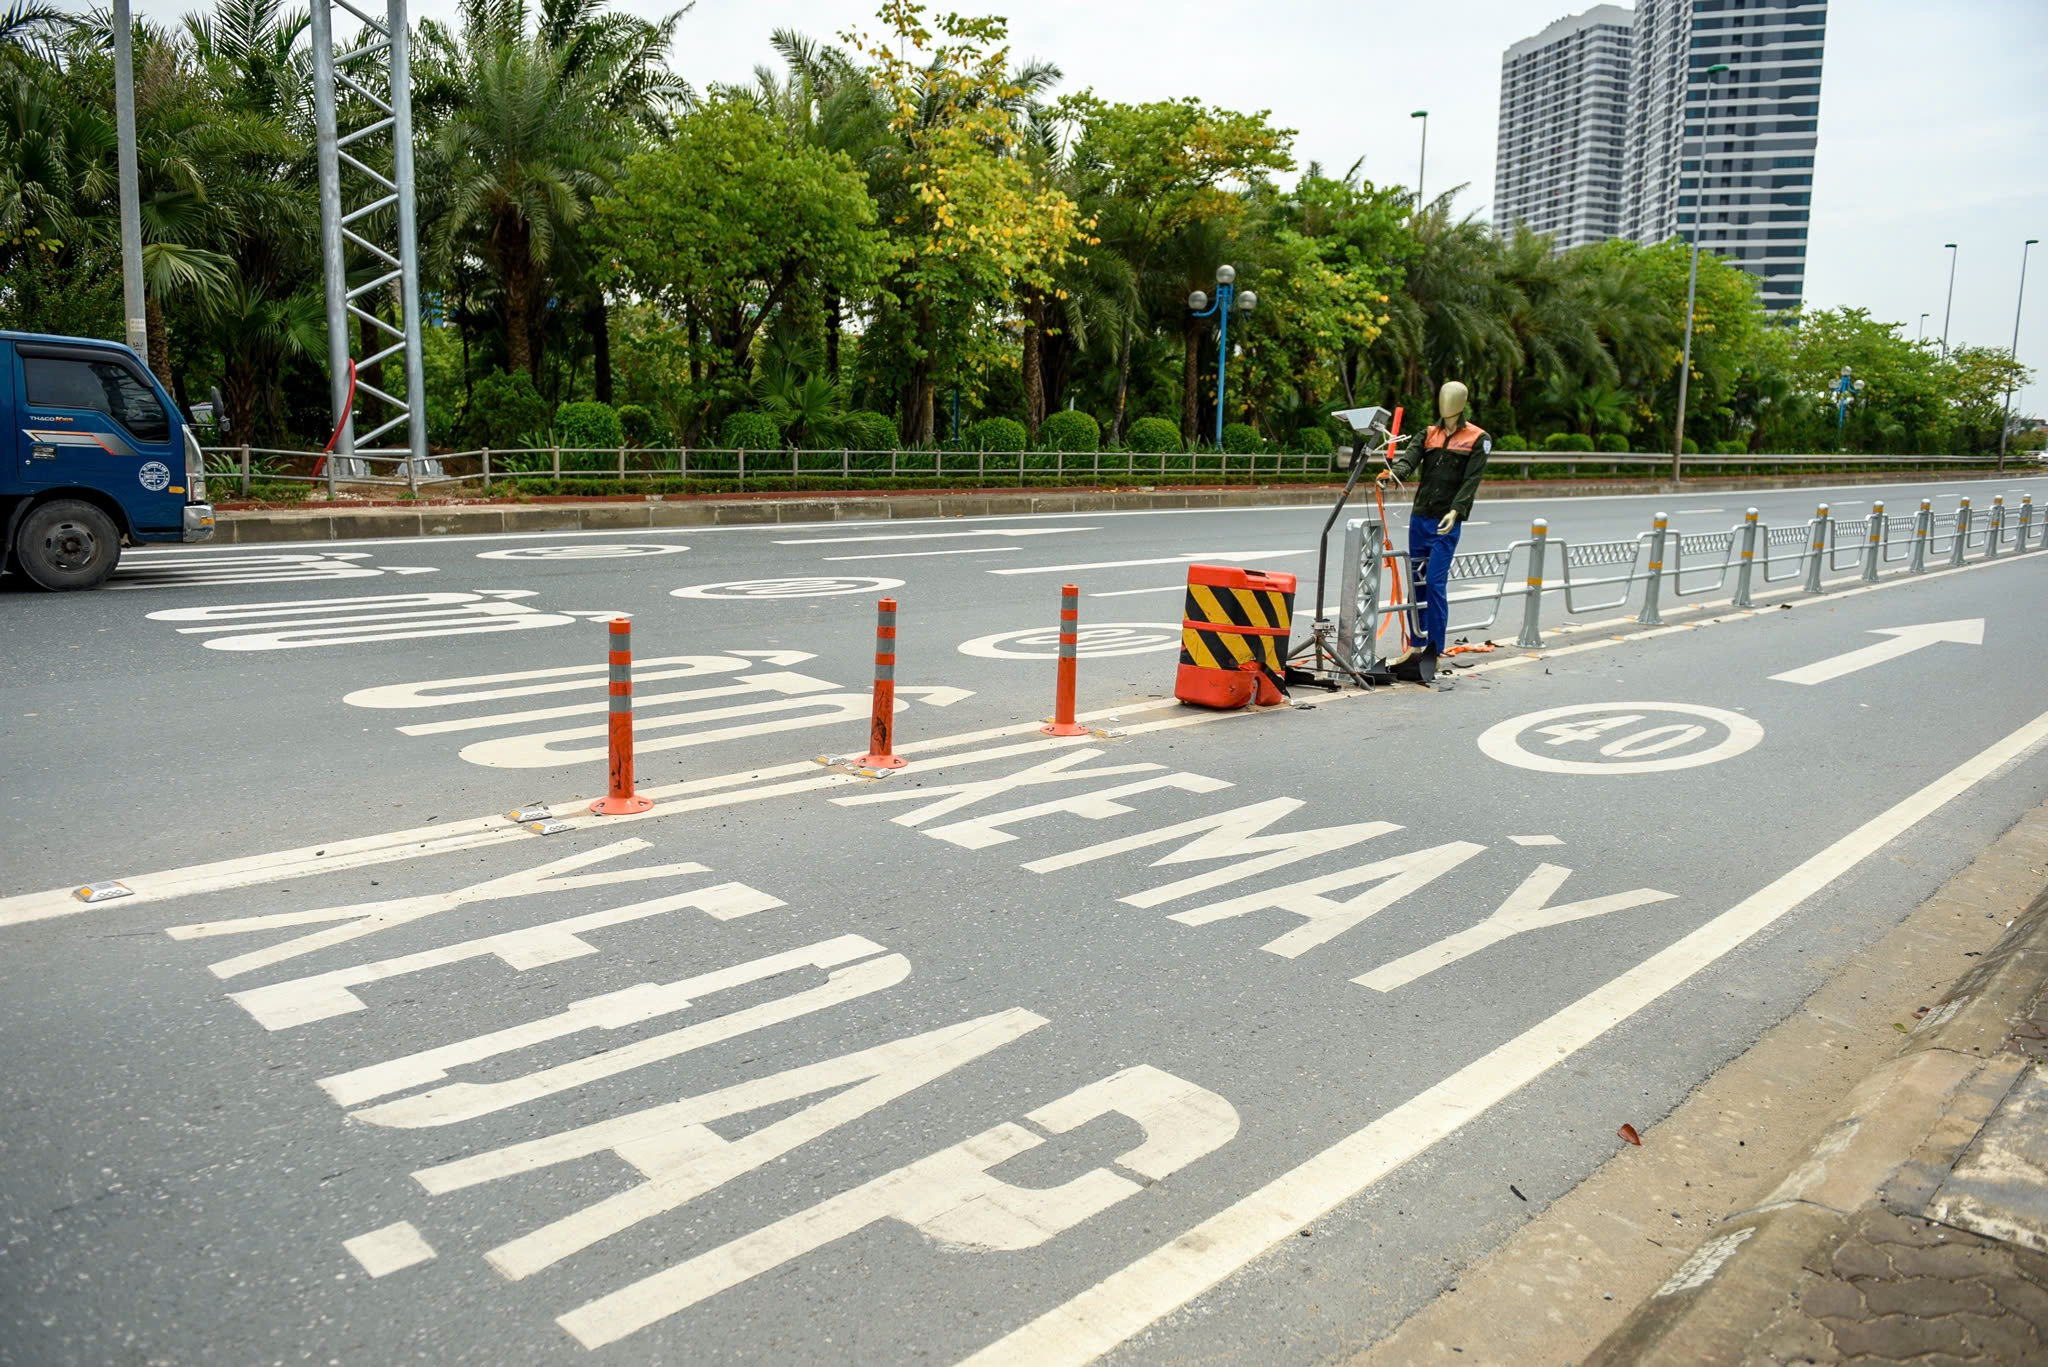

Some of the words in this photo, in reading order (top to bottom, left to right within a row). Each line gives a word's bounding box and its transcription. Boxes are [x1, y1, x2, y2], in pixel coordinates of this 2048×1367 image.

[828, 748, 1235, 850] XE
[1534, 714, 1706, 758] 40
[165, 837, 787, 1031] XE
[1021, 796, 1678, 992] MÁY
[318, 933, 1240, 1352] ĐẠP
